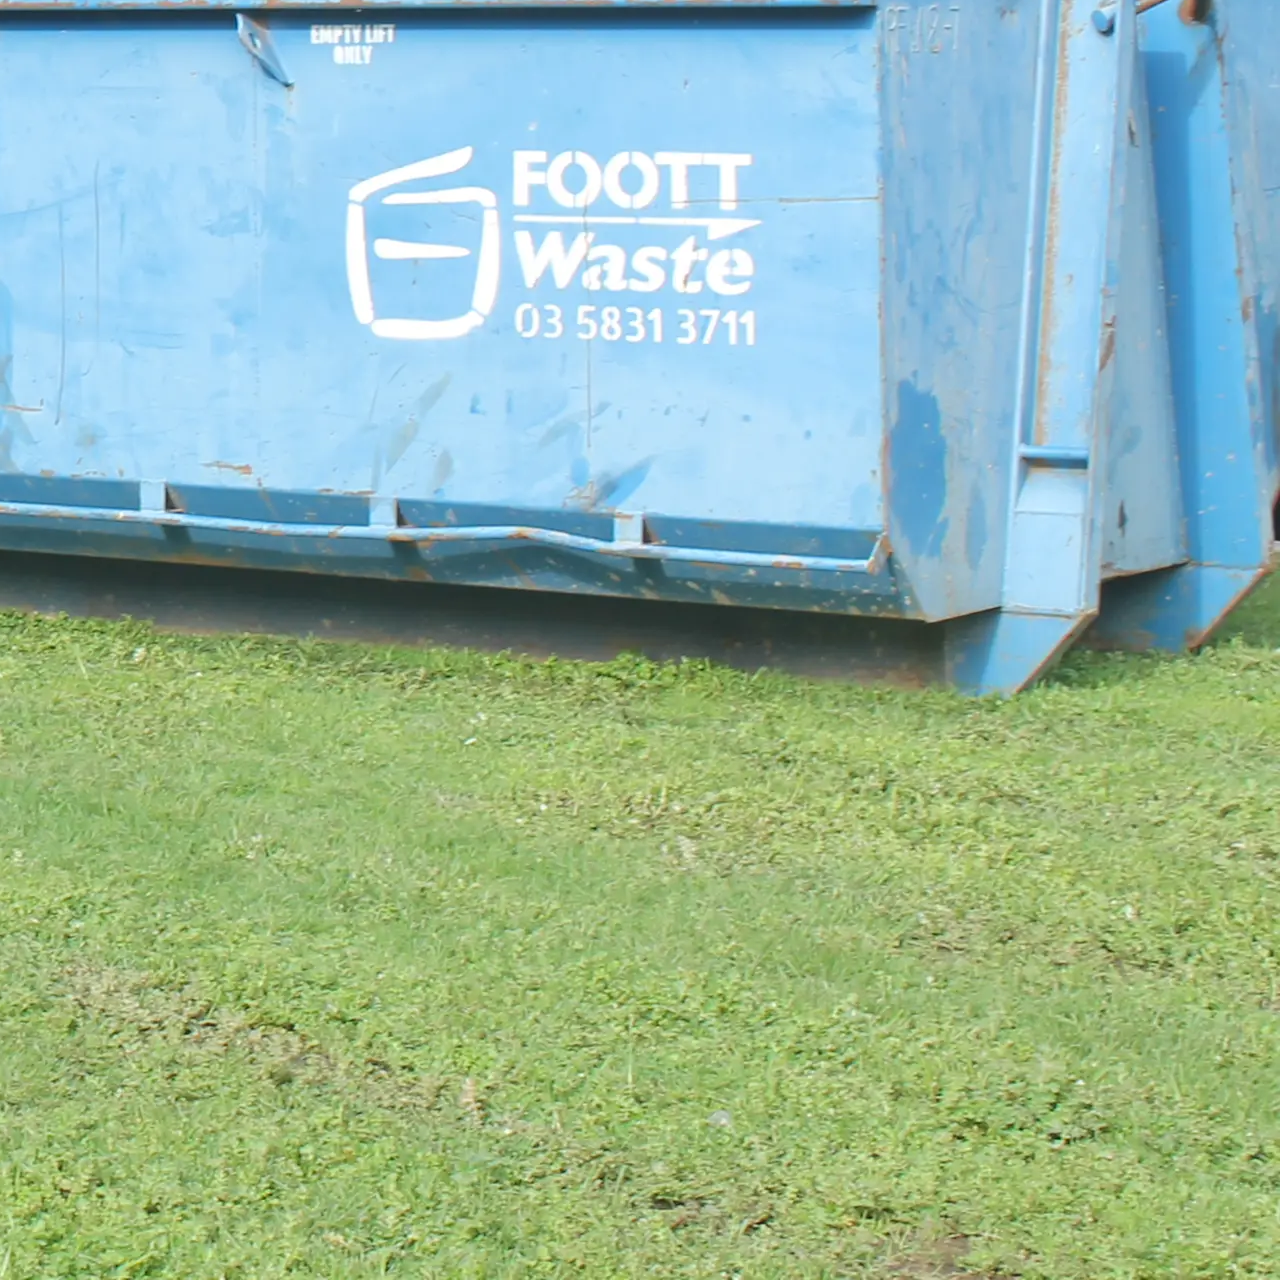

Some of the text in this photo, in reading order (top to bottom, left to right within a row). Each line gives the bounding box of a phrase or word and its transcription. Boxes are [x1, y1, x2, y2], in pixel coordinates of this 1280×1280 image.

[310, 23, 396, 44] EMPTY LIFT
[332, 45, 373, 65] ONLY
[512, 150, 753, 210] FOOTT
[513, 230, 754, 296] Waste
[514, 302, 756, 345] 03 5831 3711
